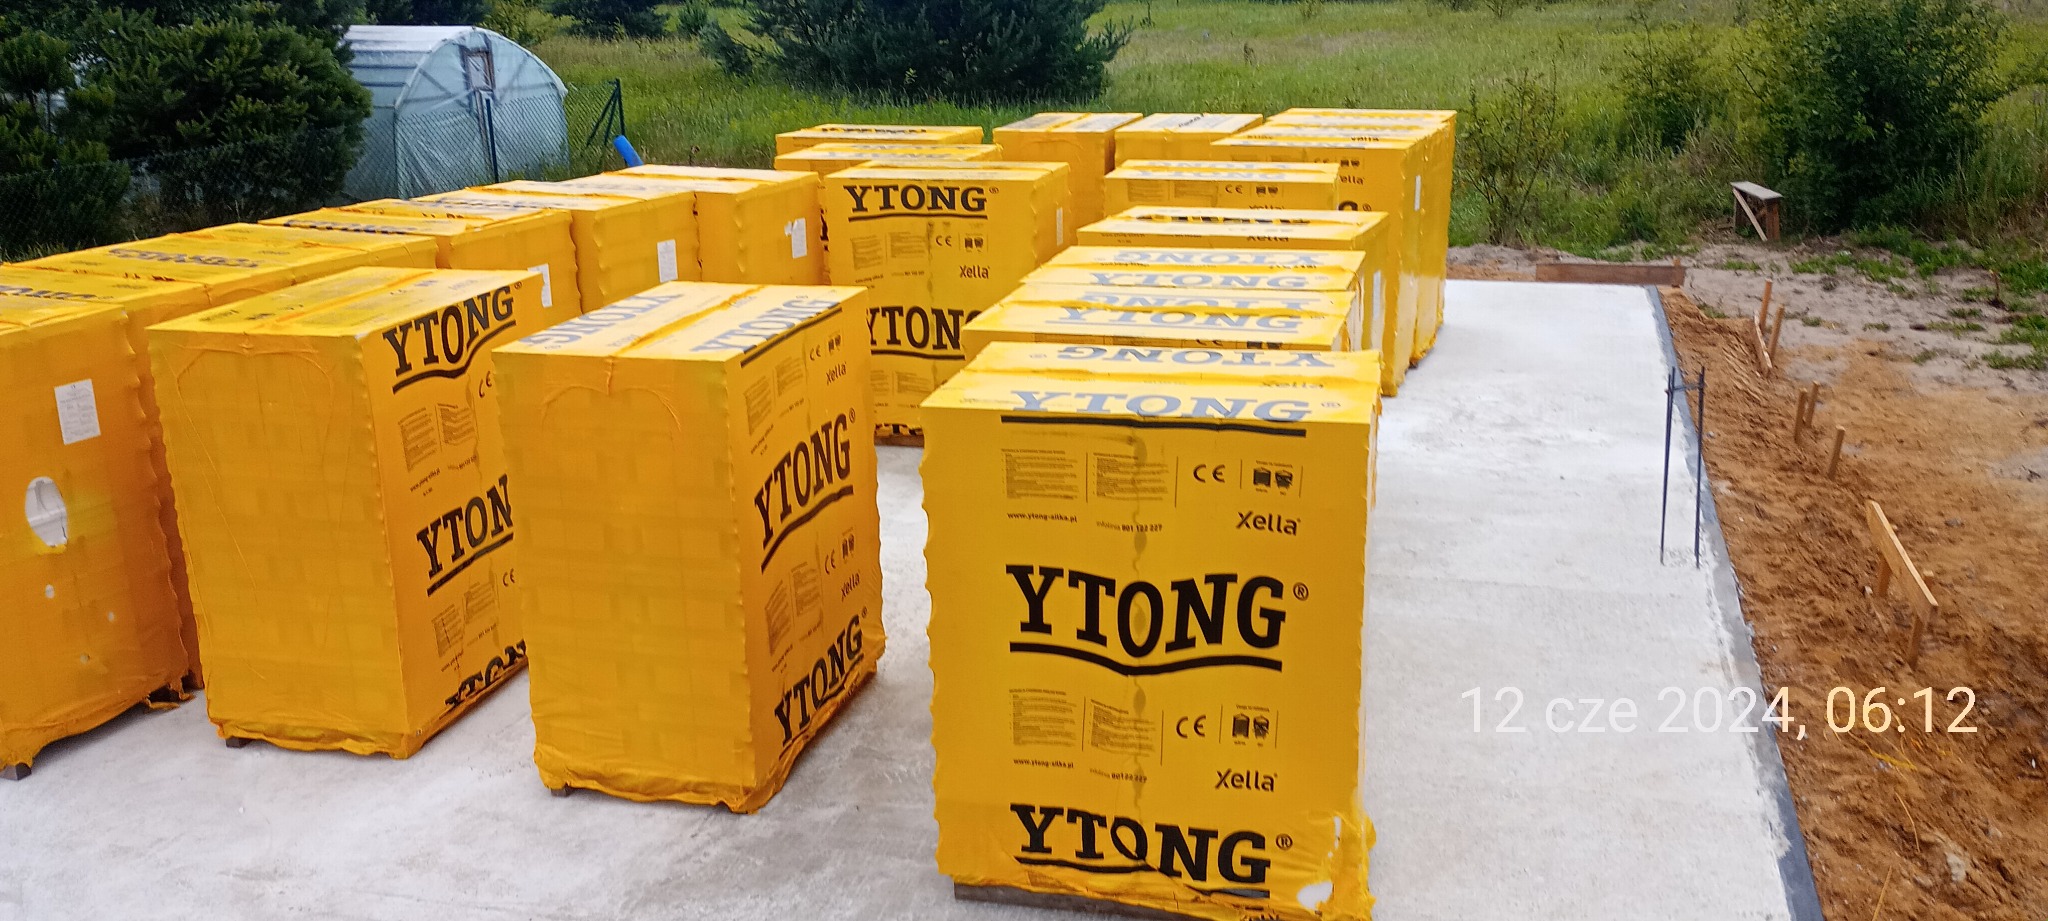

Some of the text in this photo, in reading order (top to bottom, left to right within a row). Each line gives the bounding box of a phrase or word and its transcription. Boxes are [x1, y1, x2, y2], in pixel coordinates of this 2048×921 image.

[1339, 174, 1364, 186] ella
[843, 184, 987, 213] YTONG
[959, 265, 989, 280] Xella
[382, 285, 514, 377] YTONG
[826, 361, 847, 385] Xella
[1011, 390, 1312, 423] YTONG
[754, 413, 851, 550] YTONG
[416, 473, 513, 580] YTON
[1236, 511, 1298, 536] Xella
[1006, 564, 1286, 658] YTONG
[774, 614, 864, 747] YTONG
[1215, 768, 1275, 792] Xella
[1010, 803, 1271, 884] YTONG
